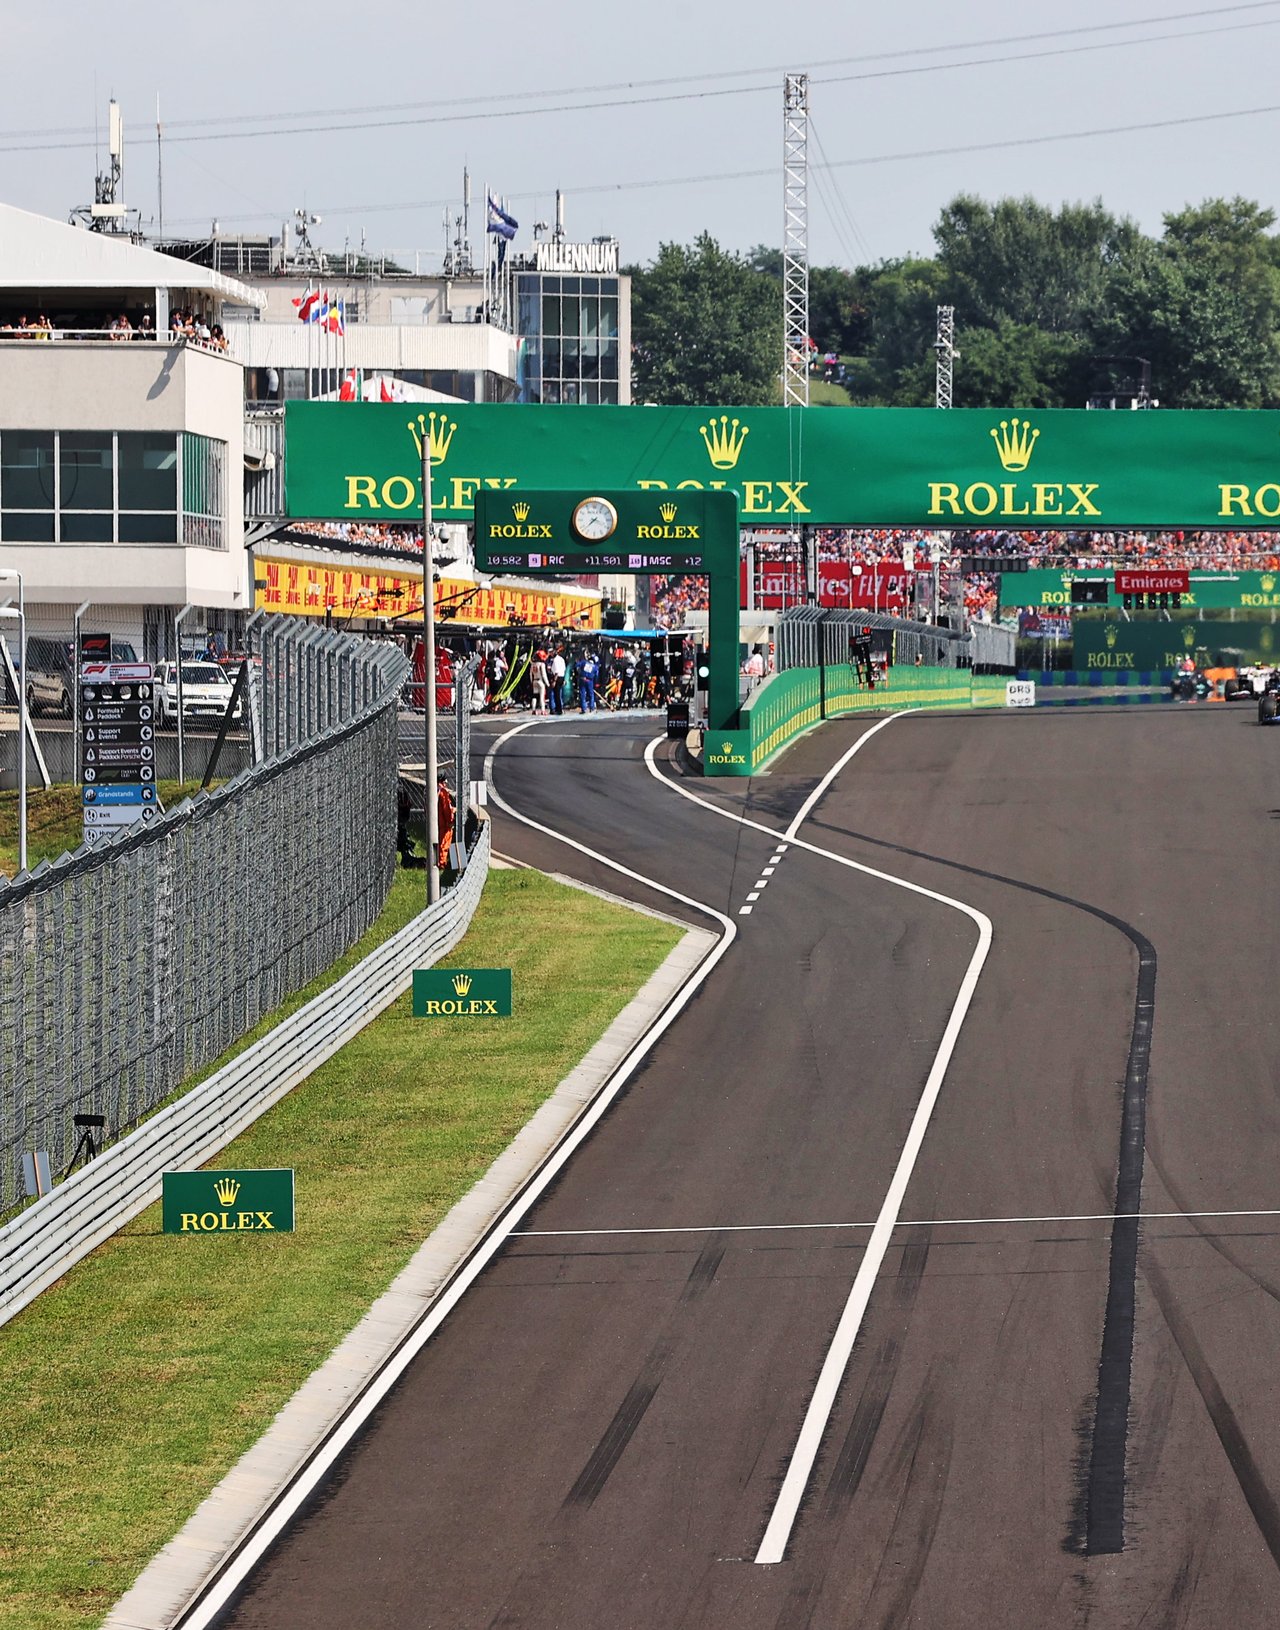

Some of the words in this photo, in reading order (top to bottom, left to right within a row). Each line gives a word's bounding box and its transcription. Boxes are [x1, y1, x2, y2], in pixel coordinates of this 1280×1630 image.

[537, 243, 617, 272] MILLENNIUM
[927, 483, 1102, 516] ROLEX
[489, 525, 552, 538] ROLEX
[636, 525, 700, 539] ROLEX
[549, 556, 565, 565] RIC
[585, 556, 622, 566] +11.501
[649, 556, 672, 566] MSC
[1121, 576, 1184, 589] Emirates
[1087, 652, 1135, 668] ROLEX
[709, 755, 746, 764] ROLEX
[426, 1000, 498, 1015] ROLEX
[180, 1211, 275, 1231] ROLEX
